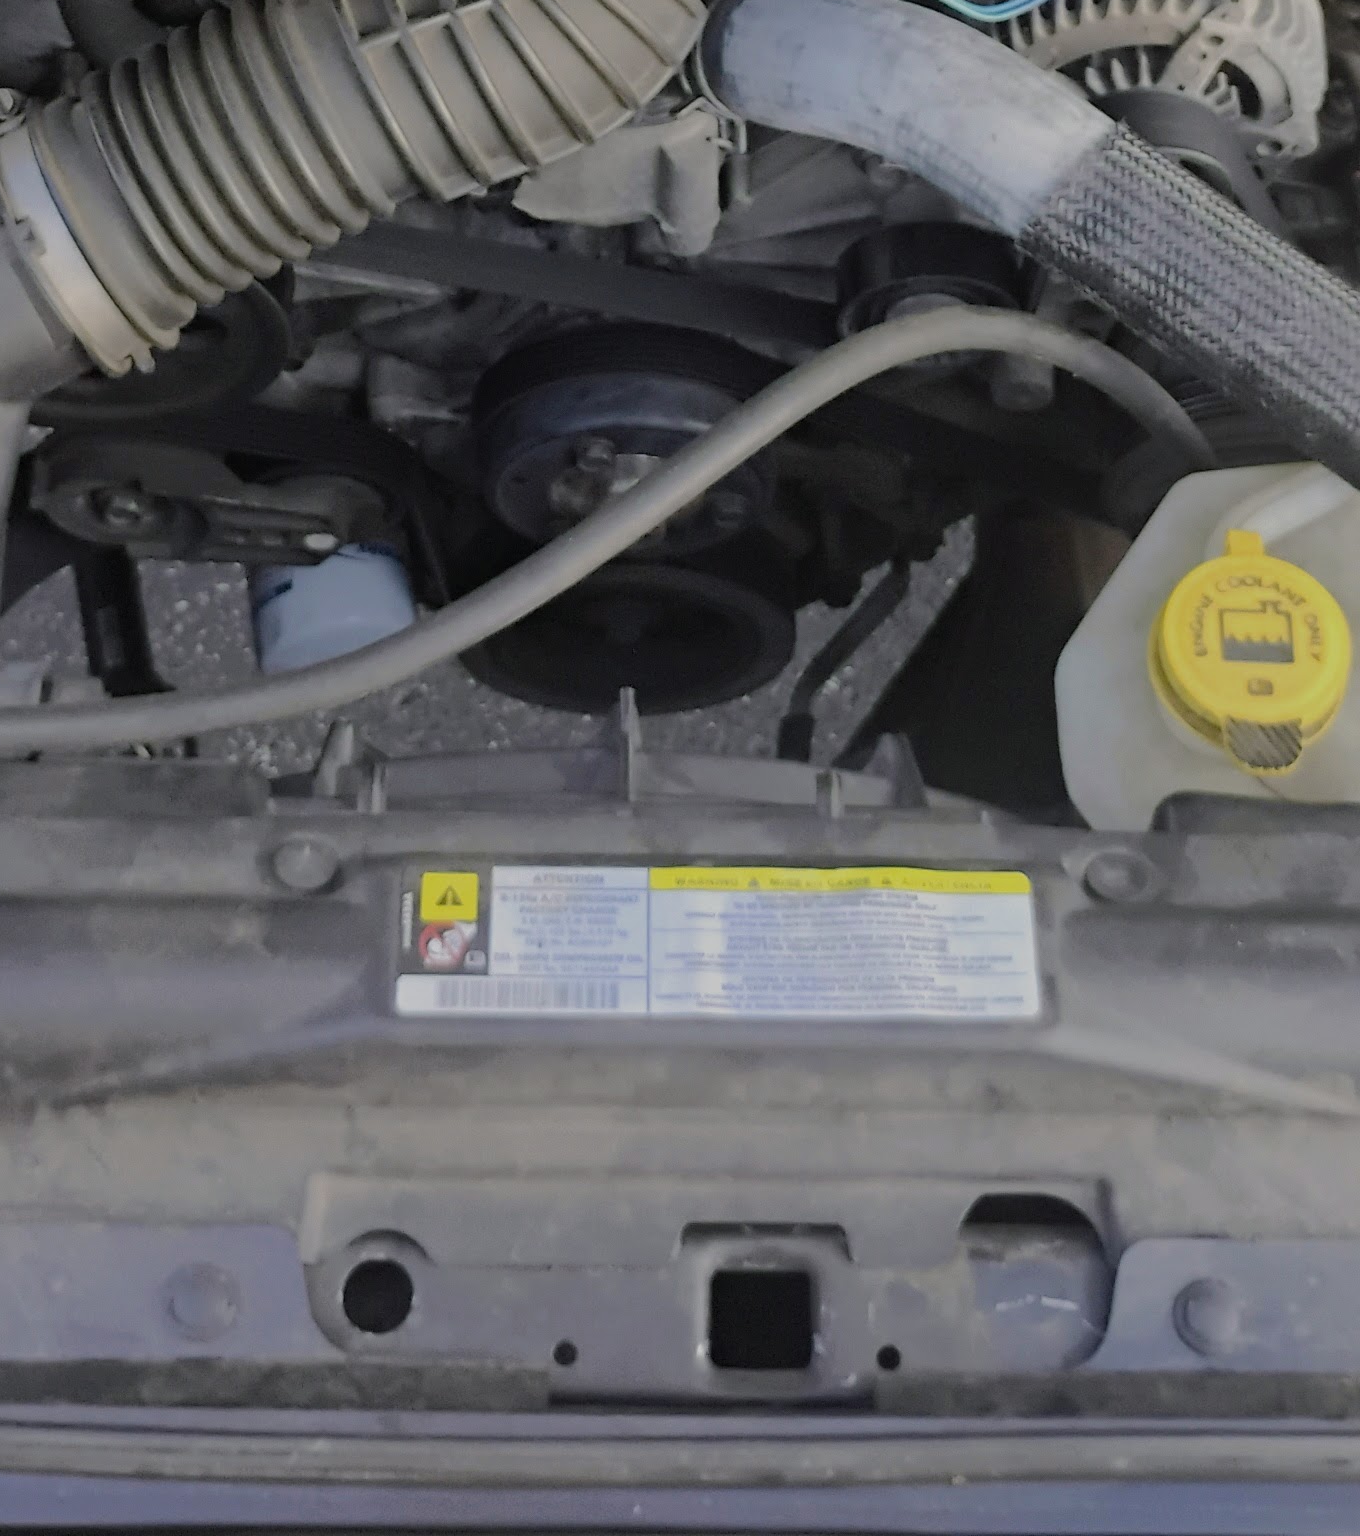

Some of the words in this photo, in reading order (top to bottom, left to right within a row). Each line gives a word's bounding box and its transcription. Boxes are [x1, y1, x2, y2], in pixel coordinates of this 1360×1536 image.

[1189, 592, 1214, 658] ENGINE
[1215, 575, 1308, 607] COOLANT
[1303, 613, 1323, 662] ONLY
